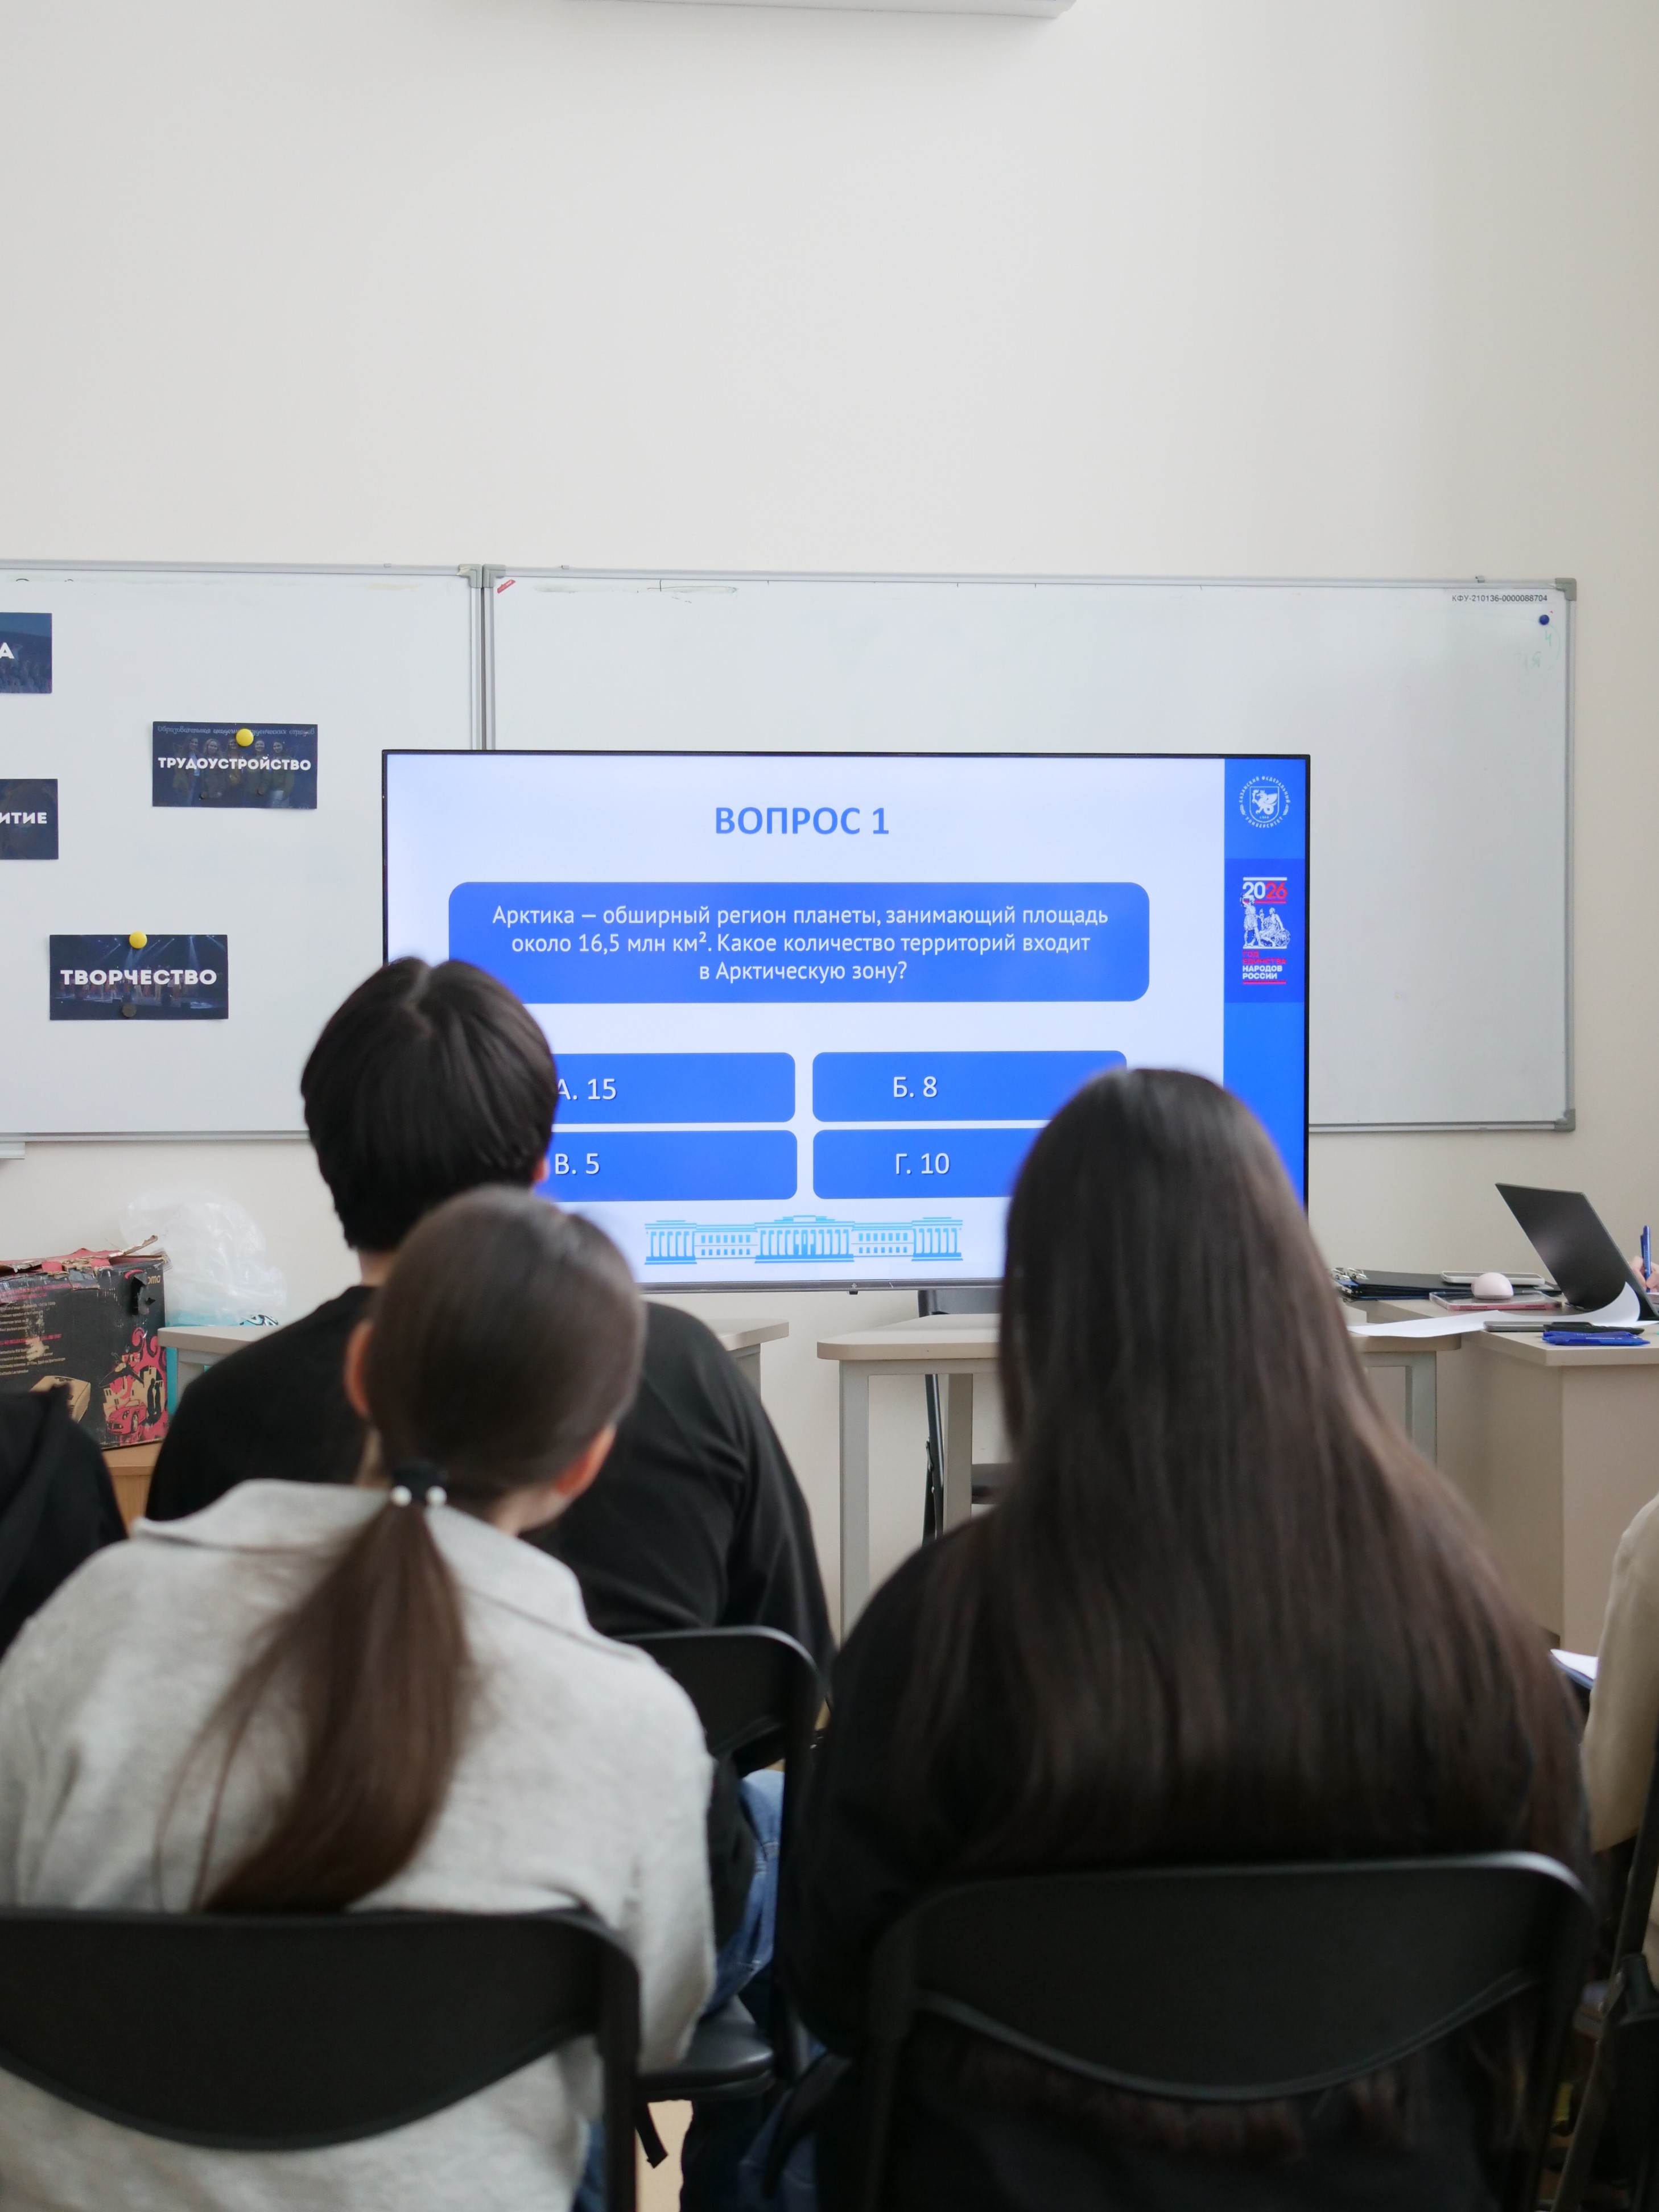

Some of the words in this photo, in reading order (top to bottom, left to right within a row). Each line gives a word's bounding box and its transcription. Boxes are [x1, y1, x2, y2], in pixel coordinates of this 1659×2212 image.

[0, 642, 15, 659] А
[158, 756, 311, 771] ТРУДОУСТРОЙСТВО
[0, 812, 47, 824] ИТИЕ
[716, 807, 860, 835] ВОПРОС
[873, 807, 889, 835] 1
[1243, 881, 1288, 899] 2026
[493, 906, 574, 928] Арктика
[603, 905, 709, 928] обширный
[717, 910, 786, 928] регион
[794, 910, 881, 927] планеты,
[886, 906, 1015, 926] занимающий
[1023, 910, 1108, 926] площадь
[511, 938, 571, 952] около
[579, 934, 620, 955] 16,5
[628, 938, 665, 952] млн
[717, 934, 777, 952] Какое
[784, 938, 895, 952] количество
[900, 933, 1015, 956] территорий
[1023, 937, 1091, 954] входит
[60, 969, 217, 985] ТВОРЧЕСТВО
[700, 966, 710, 980] в
[715, 961, 845, 984] Арктическую
[852, 960, 907, 984] зону?
[557, 1079, 577, 1100] А.
[588, 1078, 616, 1100] 15
[893, 1076, 914, 1097] Б.
[923, 1076, 937, 1097] 8
[555, 1153, 576, 1174] В.
[585, 1153, 600, 1174] 5
[895, 1153, 911, 1174] Г.
[921, 1153, 950, 1174] 10
